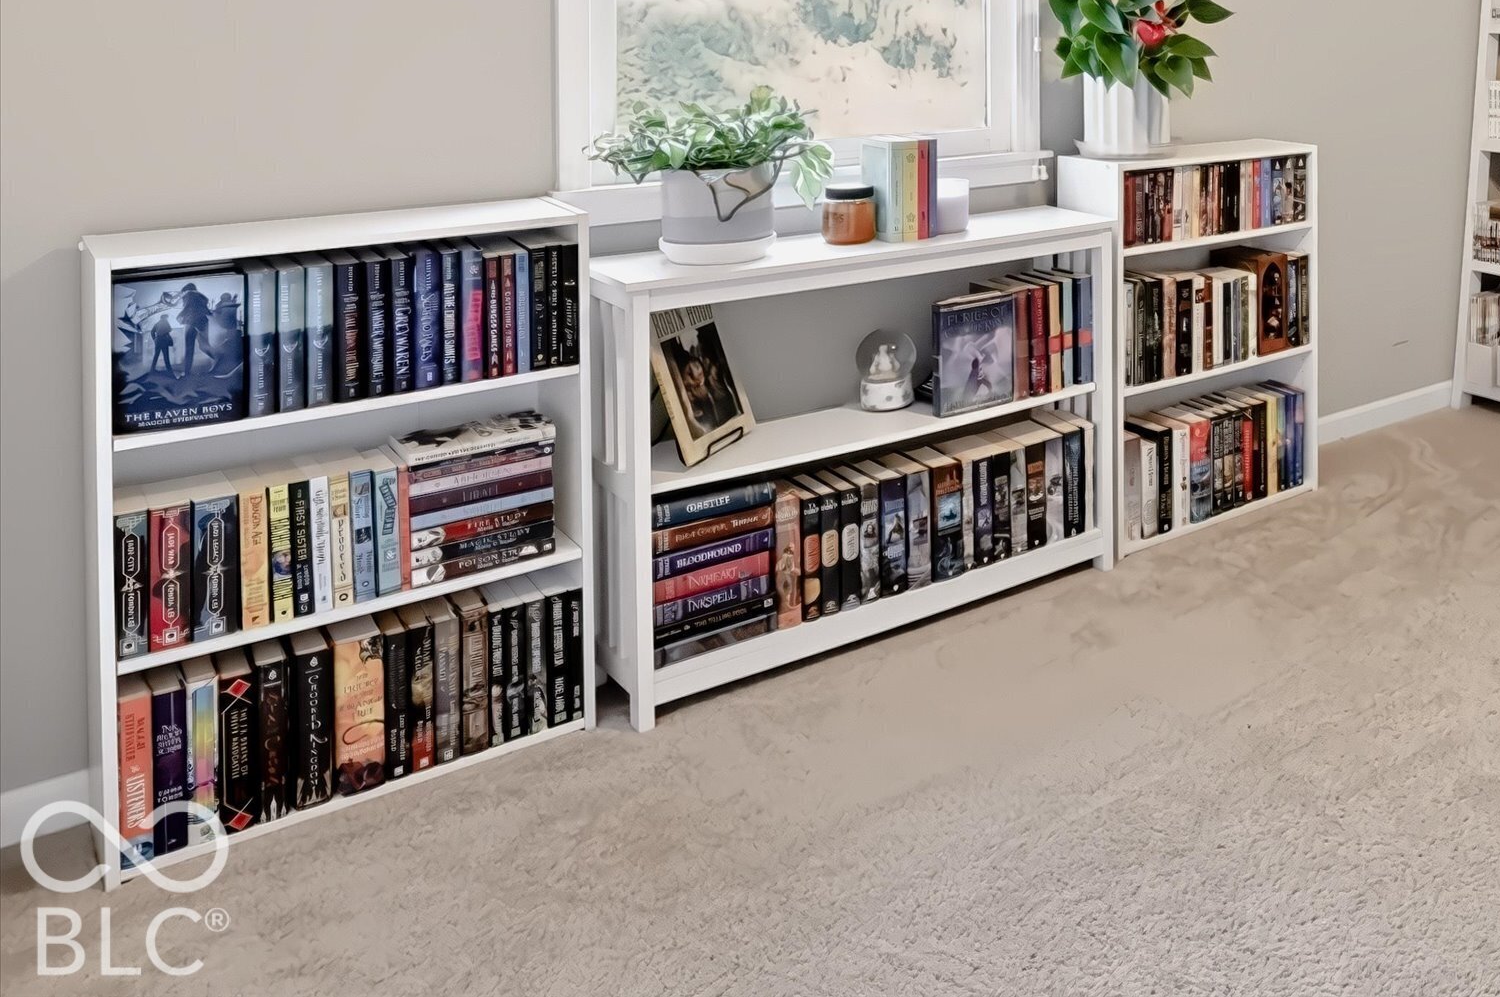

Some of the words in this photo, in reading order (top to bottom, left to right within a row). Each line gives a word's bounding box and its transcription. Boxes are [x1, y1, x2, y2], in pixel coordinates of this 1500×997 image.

[686, 304, 713, 326] HOOD
[395, 307, 411, 375] GREYWAREN
[125, 412, 150, 422] THE
[155, 407, 197, 419] RAVEN
[202, 403, 232, 413] BOYS
[295, 500, 305, 526] FIRST
[467, 519, 490, 530] FIRE
[296, 529, 307, 561] SISTER
[676, 543, 742, 569] BLOODHOUND
[459, 554, 498, 569] POISON
[688, 566, 738, 590] INKHEART
[687, 589, 738, 613] INKSPELL
[127, 773, 145, 828] LISTENERS
